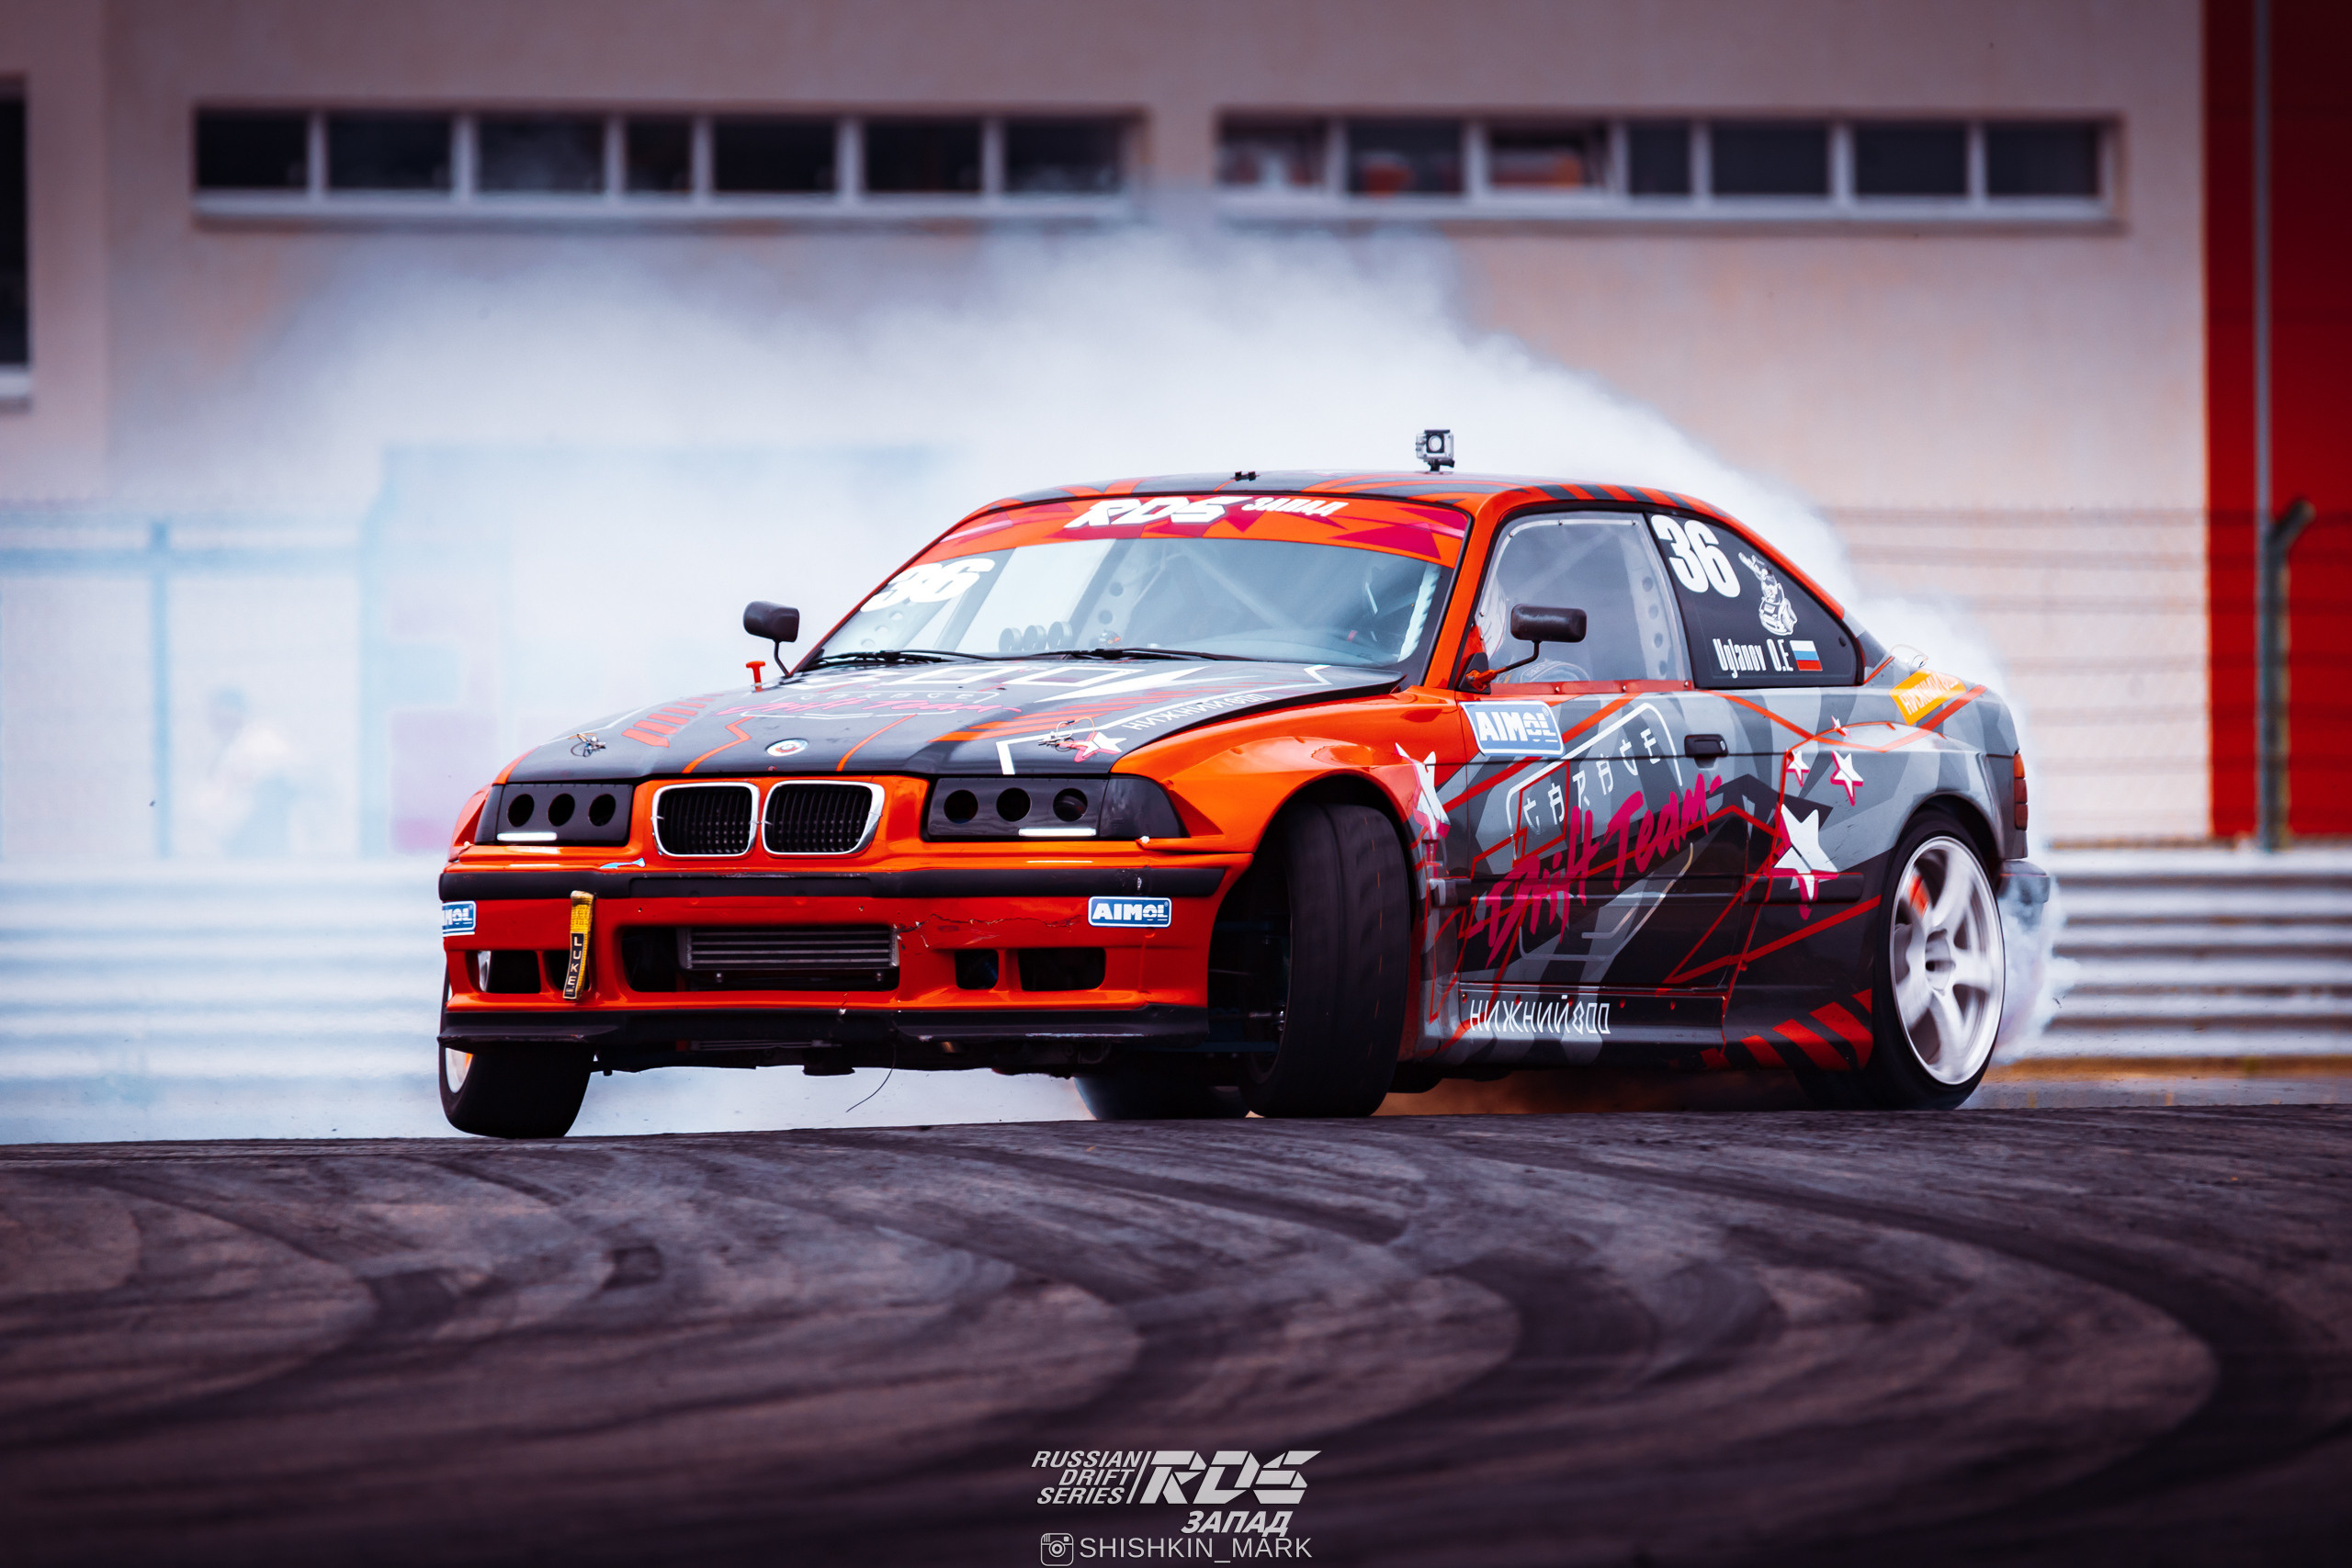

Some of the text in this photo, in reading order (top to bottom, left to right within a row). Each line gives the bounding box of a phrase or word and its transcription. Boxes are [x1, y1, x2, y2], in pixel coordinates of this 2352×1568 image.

[1064, 496, 1253, 529] RDS
[1240, 496, 1349, 517] ЗАПАД
[1651, 514, 1741, 598] 36
[860, 558, 996, 613] 36
[1713, 638, 1767, 679] Uglanov
[1475, 711, 1558, 743] AIMOL
[1091, 902, 1169, 921] AIMOL
[567, 936, 582, 986] LUKE
